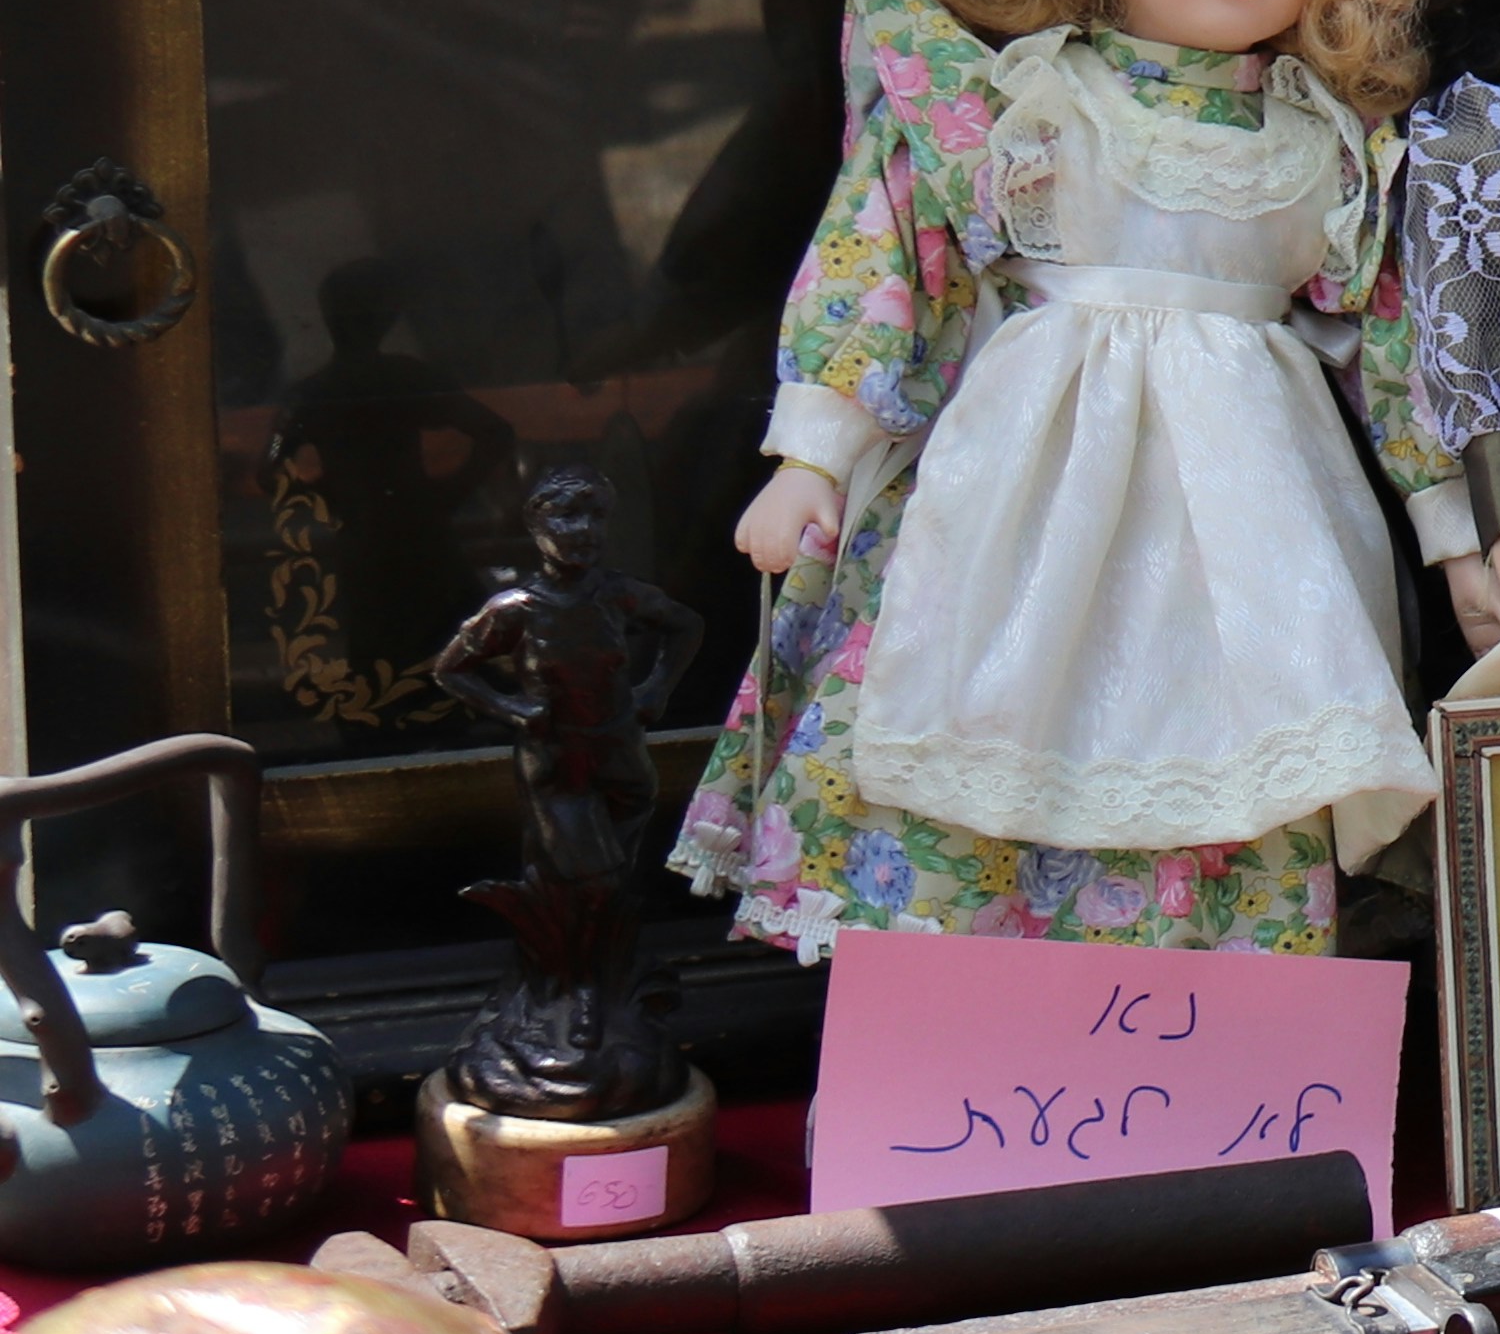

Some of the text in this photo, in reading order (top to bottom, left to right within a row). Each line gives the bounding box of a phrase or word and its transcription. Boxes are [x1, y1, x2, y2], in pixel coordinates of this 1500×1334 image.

[1090, 983, 1198, 1041] נא
[888, 1083, 1343, 1162] לא לגעת
[576, 1179, 639, 1211] 650
